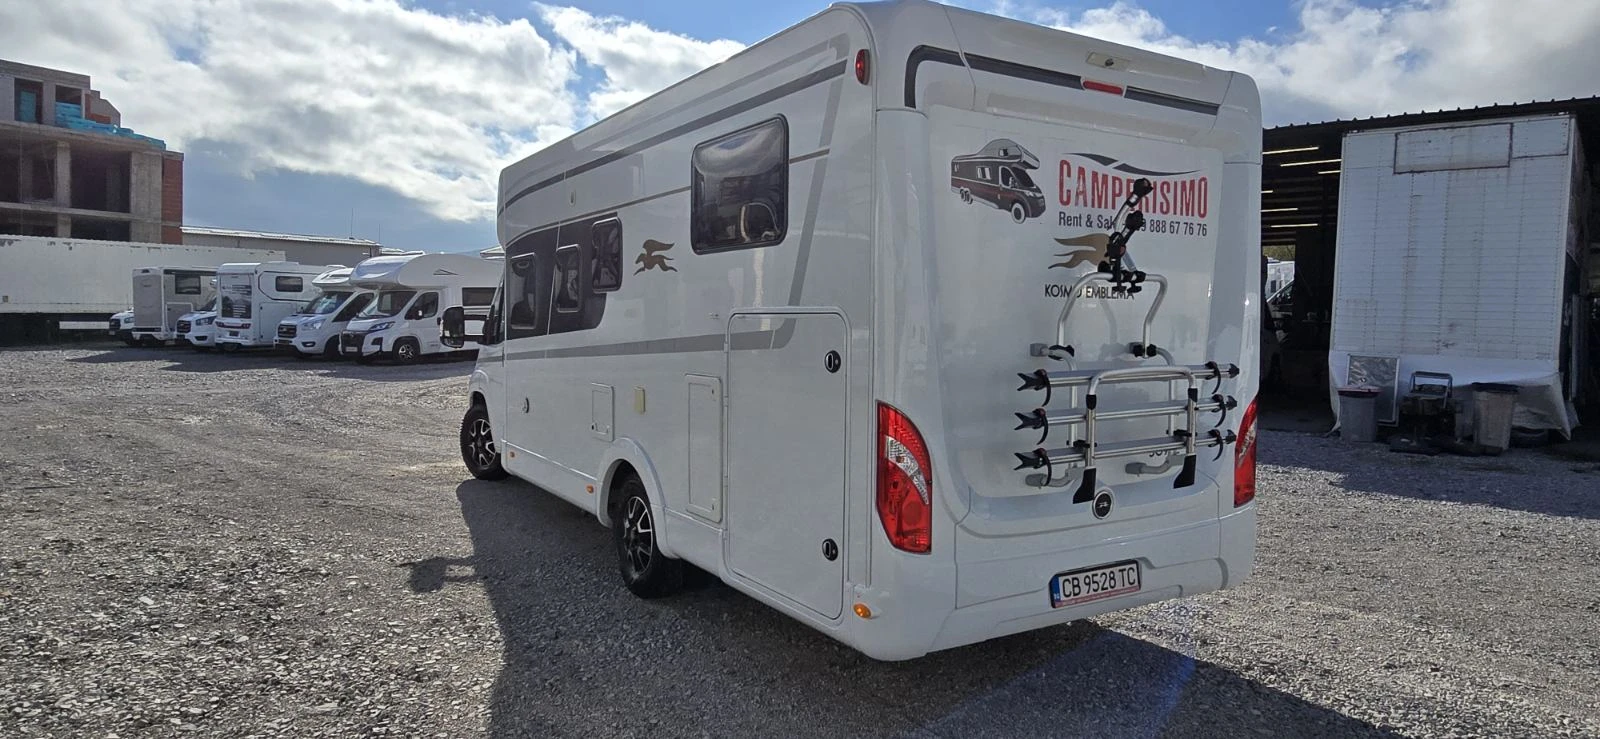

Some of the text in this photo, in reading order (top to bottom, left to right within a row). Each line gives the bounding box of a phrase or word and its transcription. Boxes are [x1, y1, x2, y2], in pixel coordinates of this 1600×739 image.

[1058, 211, 1082, 227] Rent
[1085, 214, 1093, 228] &
[1097, 214, 1116, 230] Sal
[1149, 219, 1167, 233] 888
[1169, 221, 1181, 234] 67
[1183, 222, 1194, 236] 76
[1197, 223, 1208, 237] 76
[1085, 286, 1135, 300] EMBLEMA
[1062, 577, 1082, 598] CB
[1083, 571, 1117, 594] 9528
[1118, 567, 1136, 587] TC
